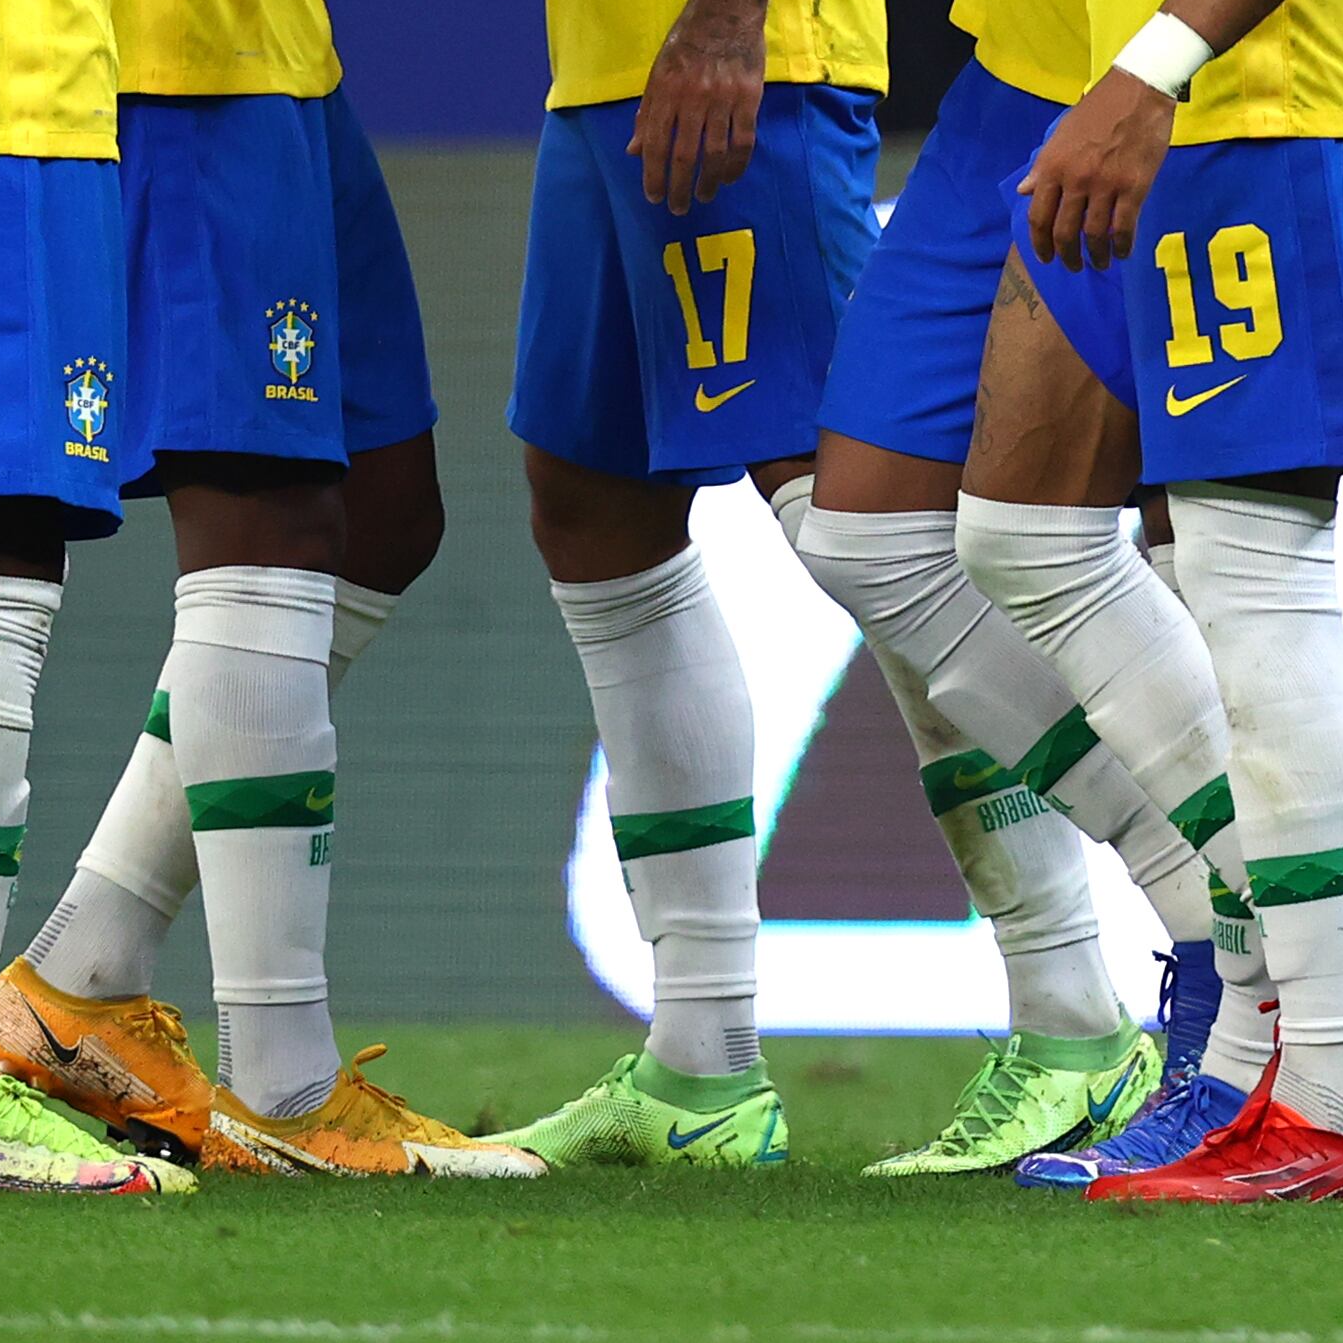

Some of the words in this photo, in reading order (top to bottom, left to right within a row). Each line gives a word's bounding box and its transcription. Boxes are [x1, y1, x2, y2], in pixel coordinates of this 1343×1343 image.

[663, 228, 756, 369] 17
[1155, 223, 1284, 368] 19
[77, 399, 95, 409] CBF
[265, 384, 319, 403] BRASIL
[65, 441, 110, 463] BRASIL
[977, 788, 1051, 833] BRASIL
